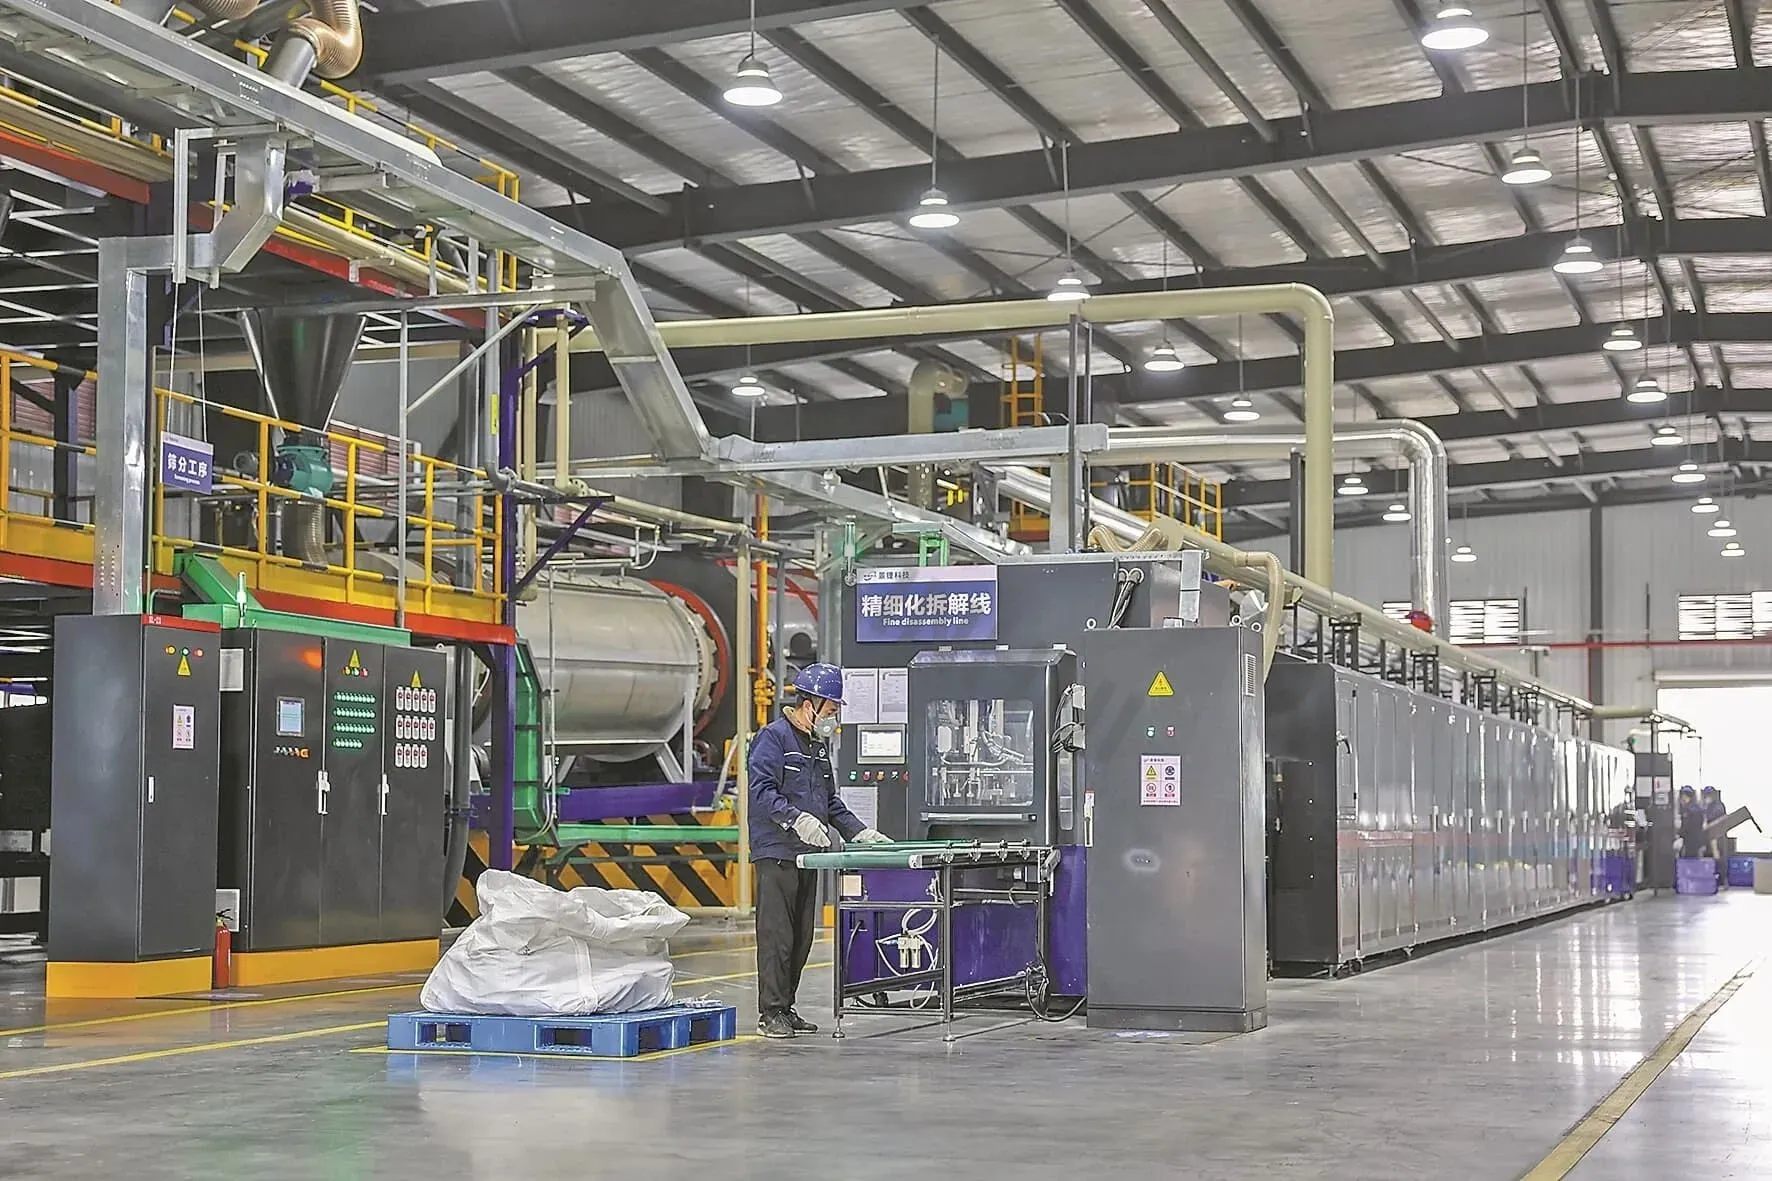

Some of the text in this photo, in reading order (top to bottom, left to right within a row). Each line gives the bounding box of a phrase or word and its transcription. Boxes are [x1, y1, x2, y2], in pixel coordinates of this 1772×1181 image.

[861, 592, 992, 617] 精细化拆解线
[883, 616, 969, 627] Fine disassembly line
